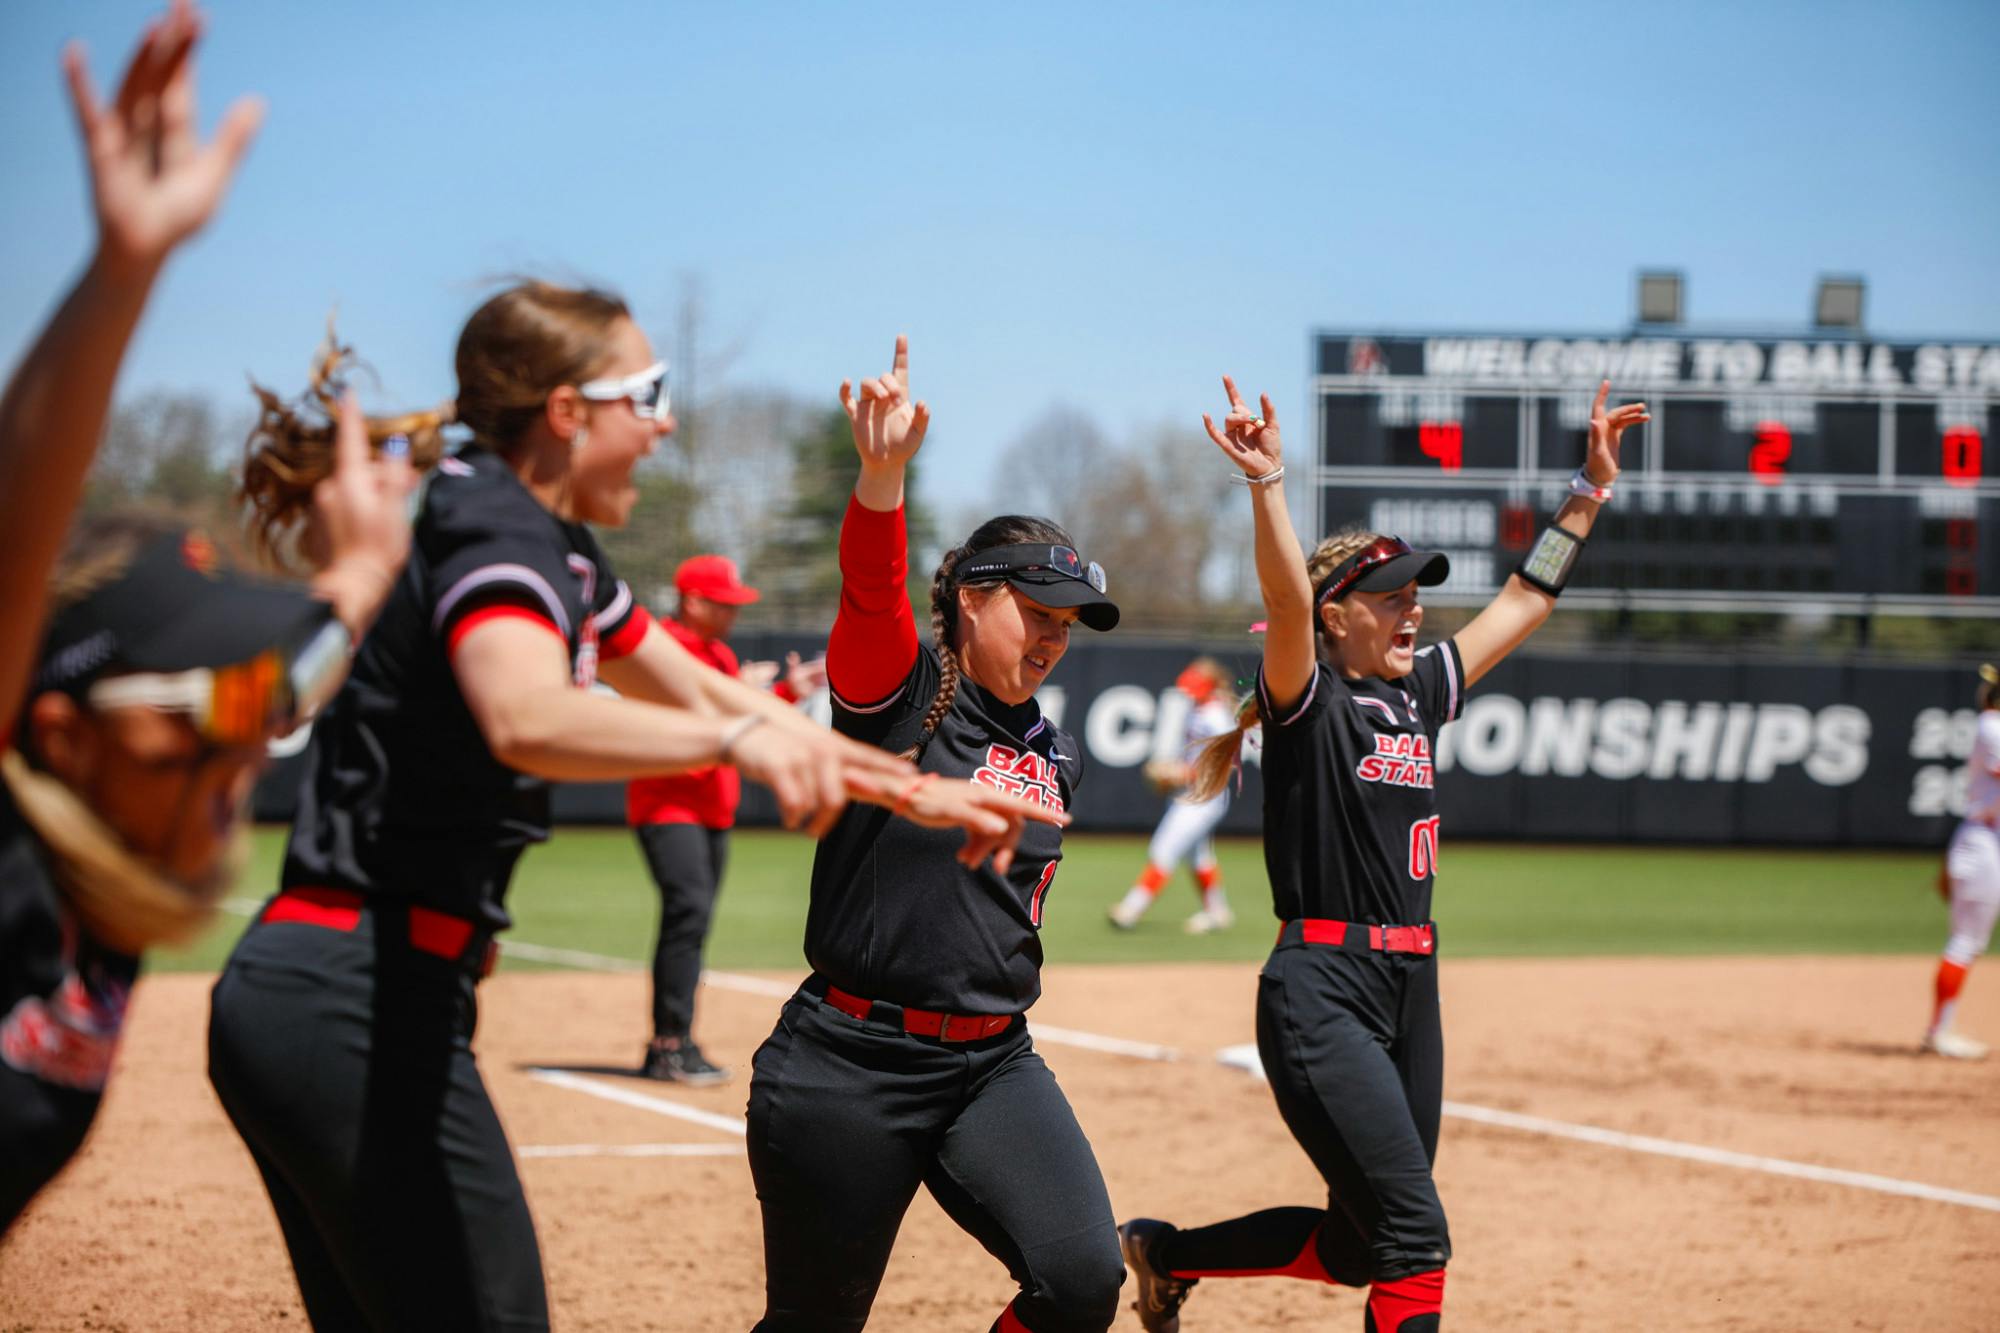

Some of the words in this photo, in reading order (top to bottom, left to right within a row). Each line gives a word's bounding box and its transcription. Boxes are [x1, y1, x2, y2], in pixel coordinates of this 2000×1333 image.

[1422, 337, 1682, 383] WELCOME
[1692, 340, 1764, 386] TO
[1769, 341, 1902, 388] BALL
[1419, 420, 1463, 472] 4
[1749, 420, 1793, 485] 2
[1942, 424, 1982, 487] 0
[986, 742, 1059, 794] BALL
